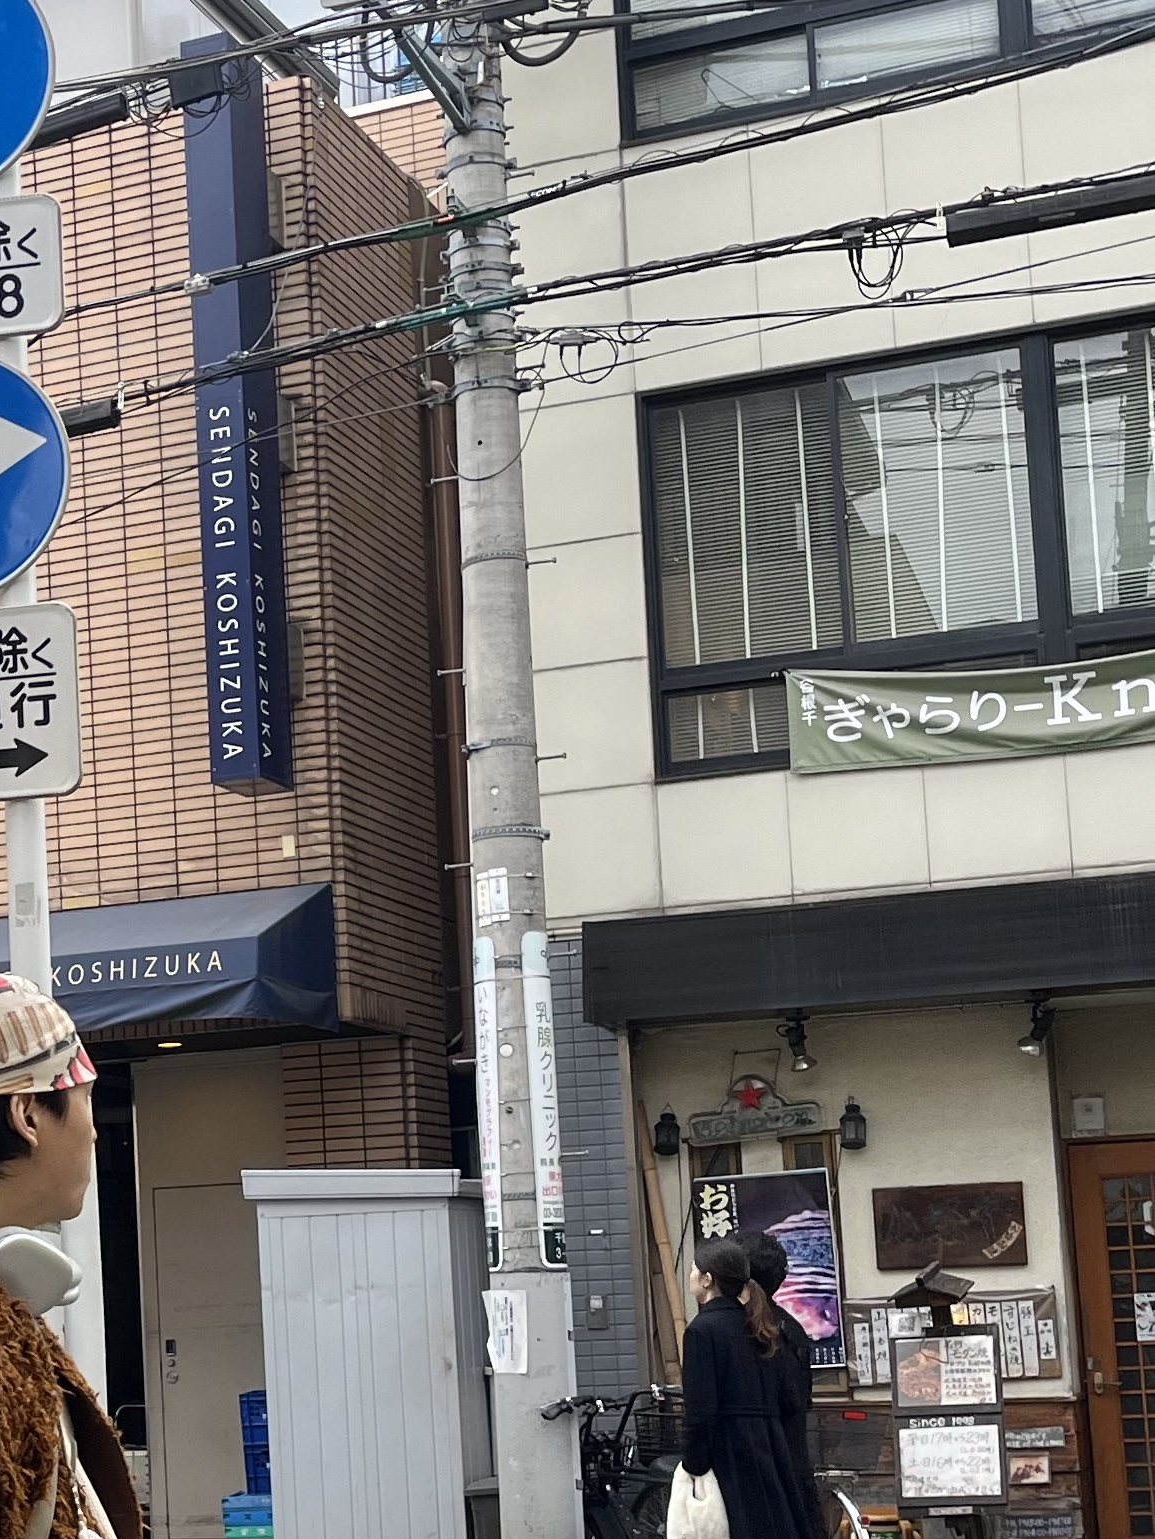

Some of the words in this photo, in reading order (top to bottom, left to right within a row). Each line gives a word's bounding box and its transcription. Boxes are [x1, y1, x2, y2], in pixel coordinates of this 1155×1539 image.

[209, 405, 236, 549] SENDAGI
[247, 407, 263, 551] SENDAGI
[215, 572, 244, 760] KOSHIZUKA
[253, 573, 272, 758] KOSHIZUKA
[51, 949, 223, 988] KOSHIZUKA
[477, 986, 490, 1074] いながき
[535, 1001, 558, 1152] 乳腺クリニック
[698, 1183, 733, 1239] お好
